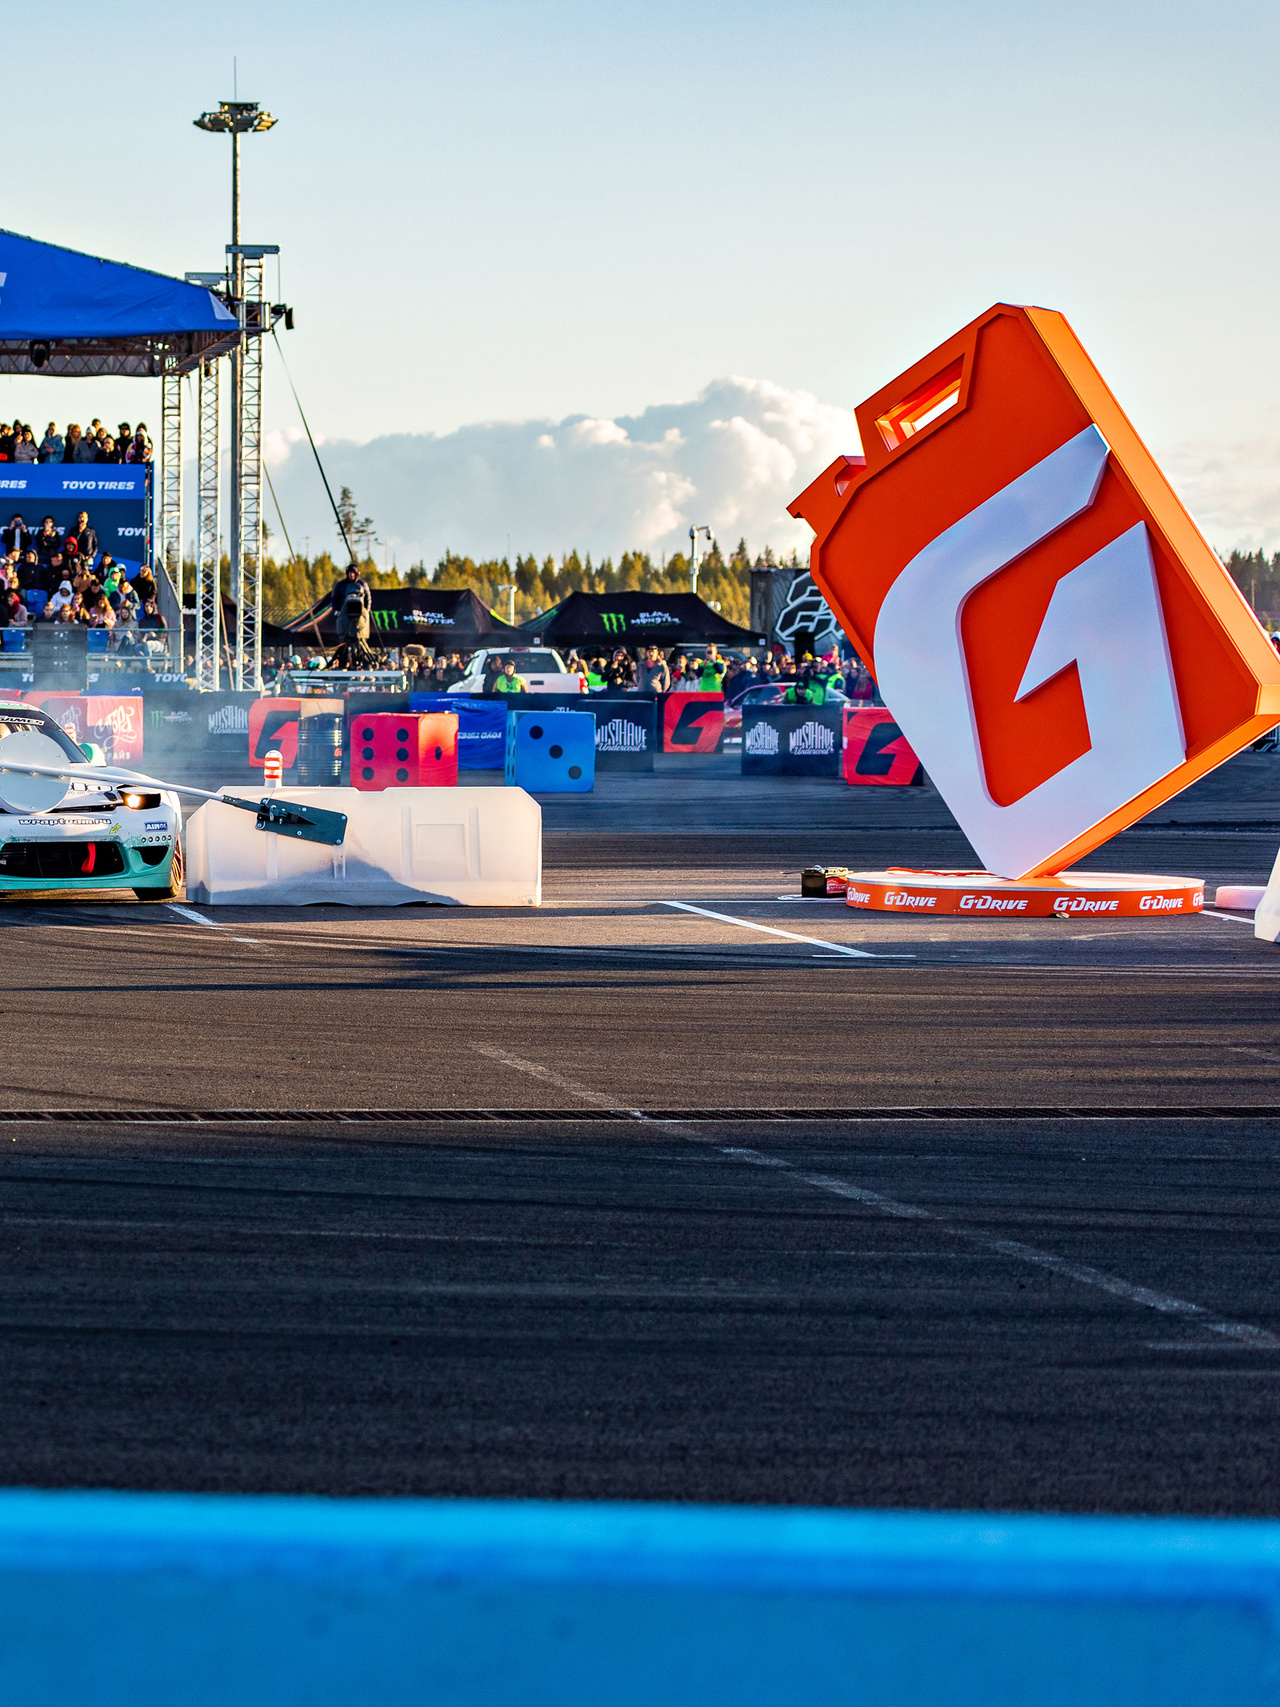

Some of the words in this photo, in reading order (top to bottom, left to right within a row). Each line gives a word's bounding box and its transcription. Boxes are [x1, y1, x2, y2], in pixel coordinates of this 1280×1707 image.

[62, 480, 96, 490] TOYO
[97, 480, 136, 490] TIRES
[873, 423, 1186, 880] G
[106, 750, 131, 760] РАЙВ
